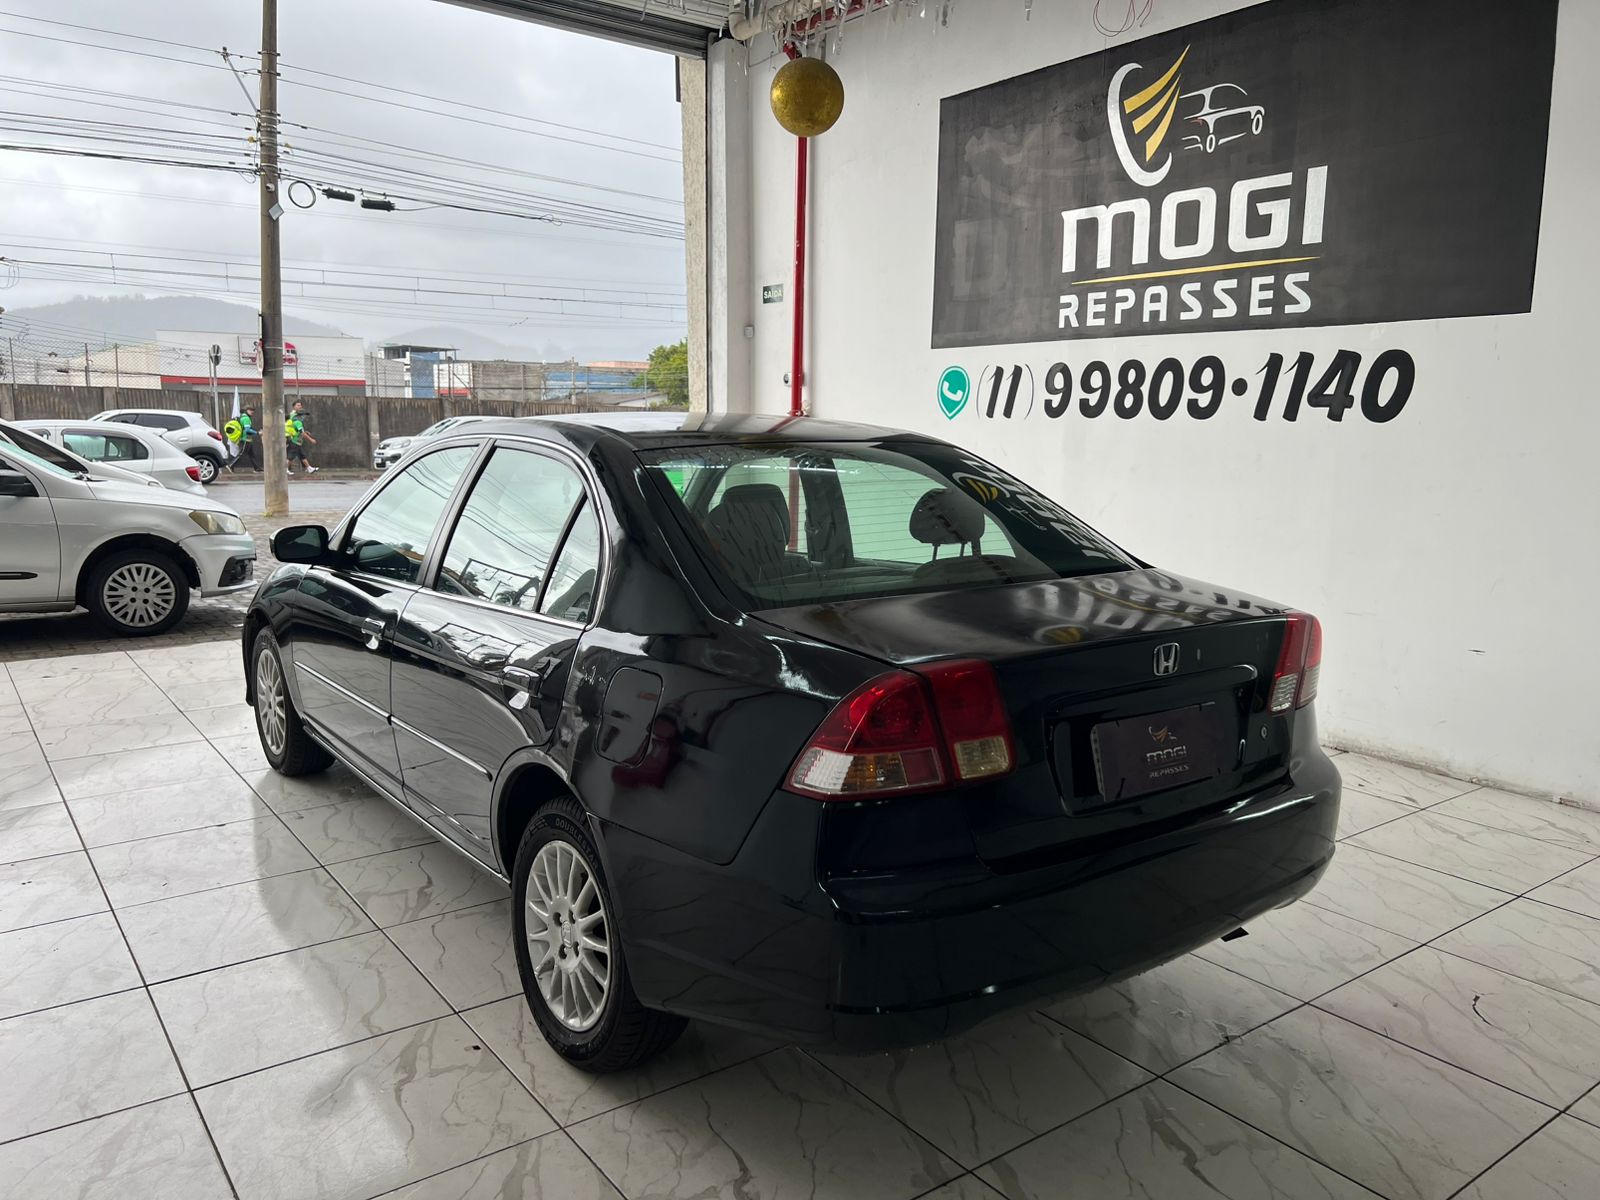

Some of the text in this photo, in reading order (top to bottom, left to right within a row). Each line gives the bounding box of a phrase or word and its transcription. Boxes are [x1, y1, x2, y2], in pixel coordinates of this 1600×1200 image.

[1060, 165, 1329, 274] MOGI
[1058, 271, 1312, 329] REPASSES
[976, 363, 1034, 420] (11)
